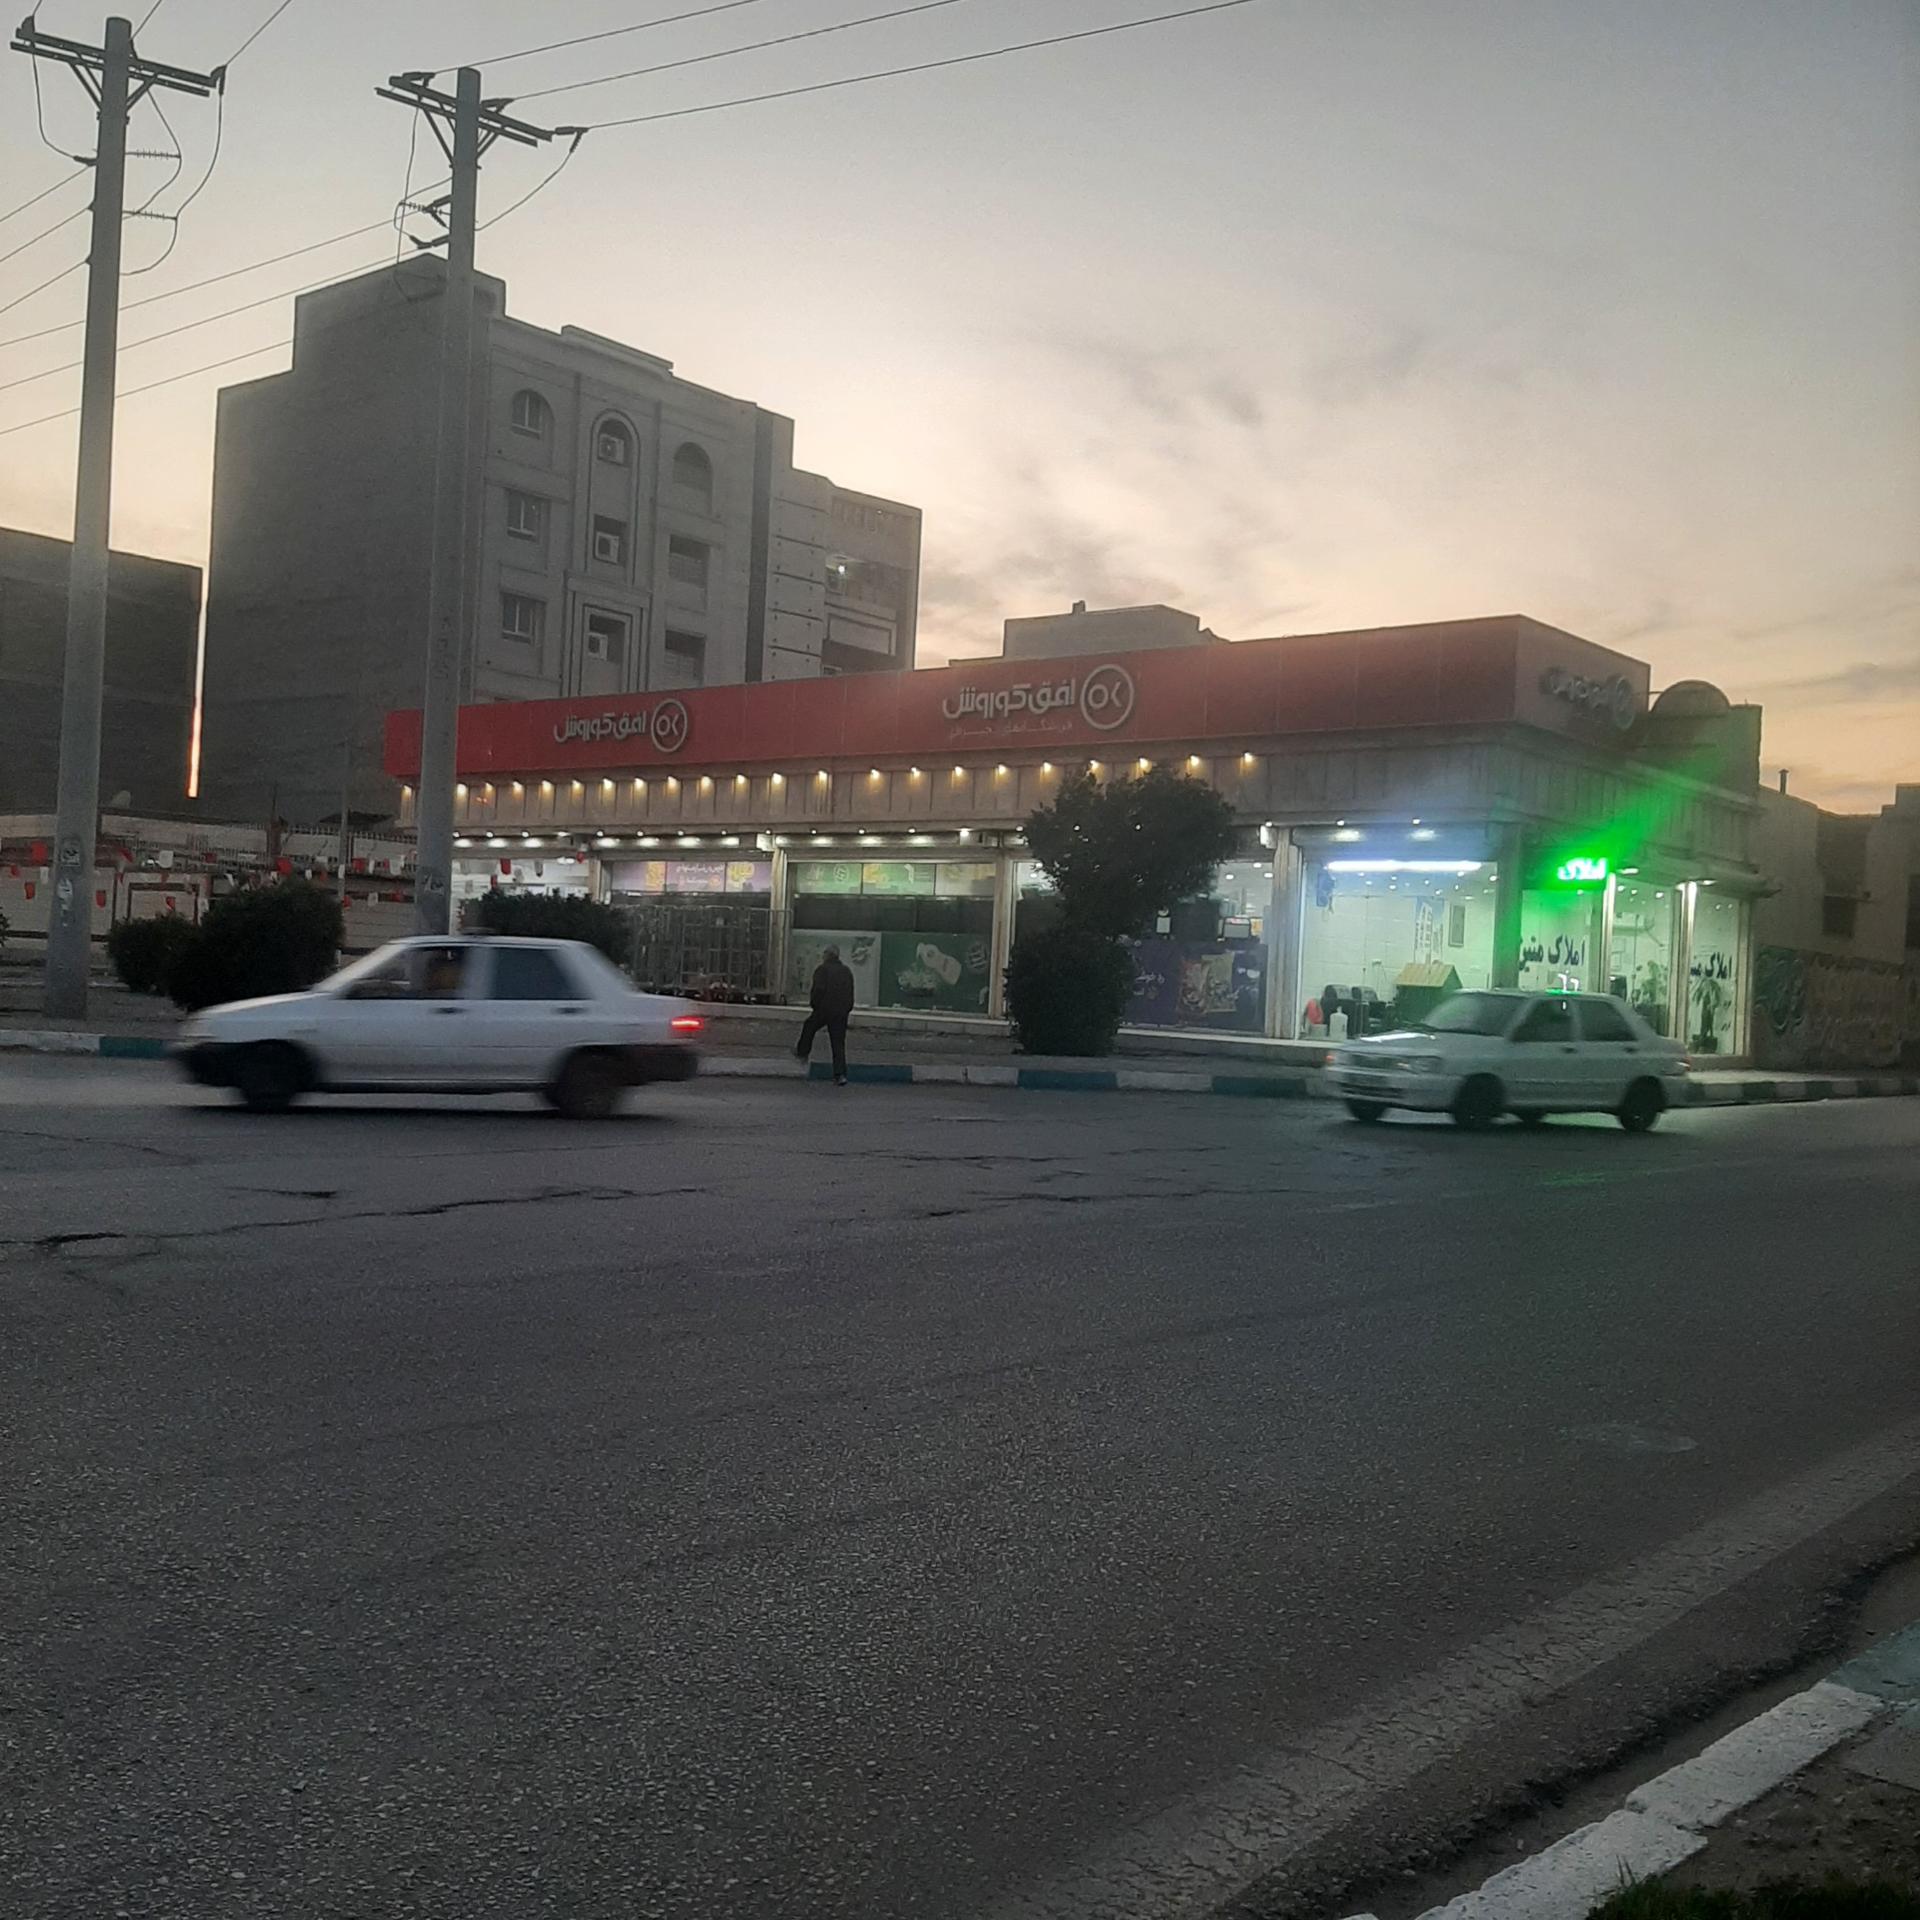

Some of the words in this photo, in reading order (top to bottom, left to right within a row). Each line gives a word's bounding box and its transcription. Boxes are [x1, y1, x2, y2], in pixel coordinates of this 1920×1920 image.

[942, 683, 1031, 720] کوروش
[1028, 677, 1076, 715] افق
[553, 712, 615, 743] کوروش
[612, 711, 647, 741] افق
[1557, 857, 1607, 881] املاک
[1547, 934, 1586, 967] املاک
[1704, 951, 1732, 980] املاک
